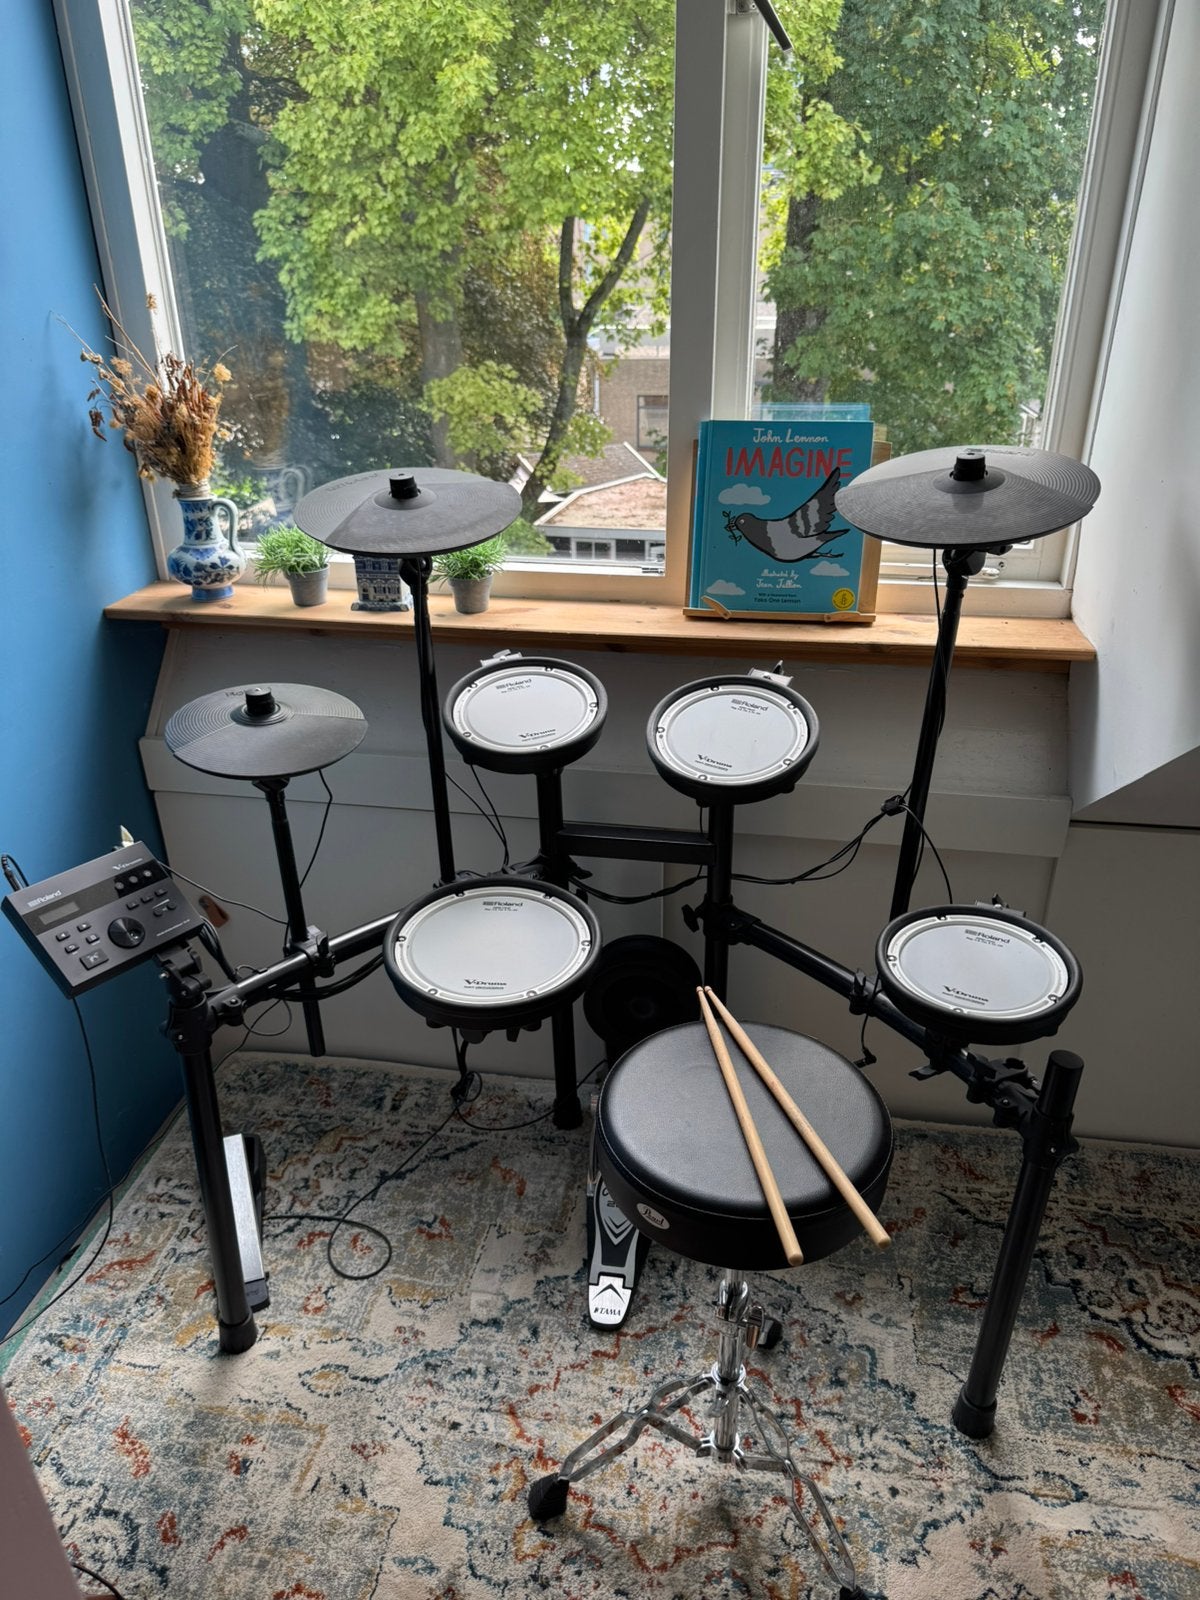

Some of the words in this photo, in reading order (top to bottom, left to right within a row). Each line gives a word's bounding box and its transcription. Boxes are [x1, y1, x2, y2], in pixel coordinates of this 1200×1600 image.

[753, 427, 783, 443] John
[785, 428, 829, 444] Lennon
[726, 446, 853, 479] IMAGINE
[741, 700, 769, 712] Roland
[37, 889, 63, 904] Roland
[977, 932, 1011, 944] Roland
[643, 1208, 665, 1226] Pearl
[600, 1308, 621, 1317] TAMA
